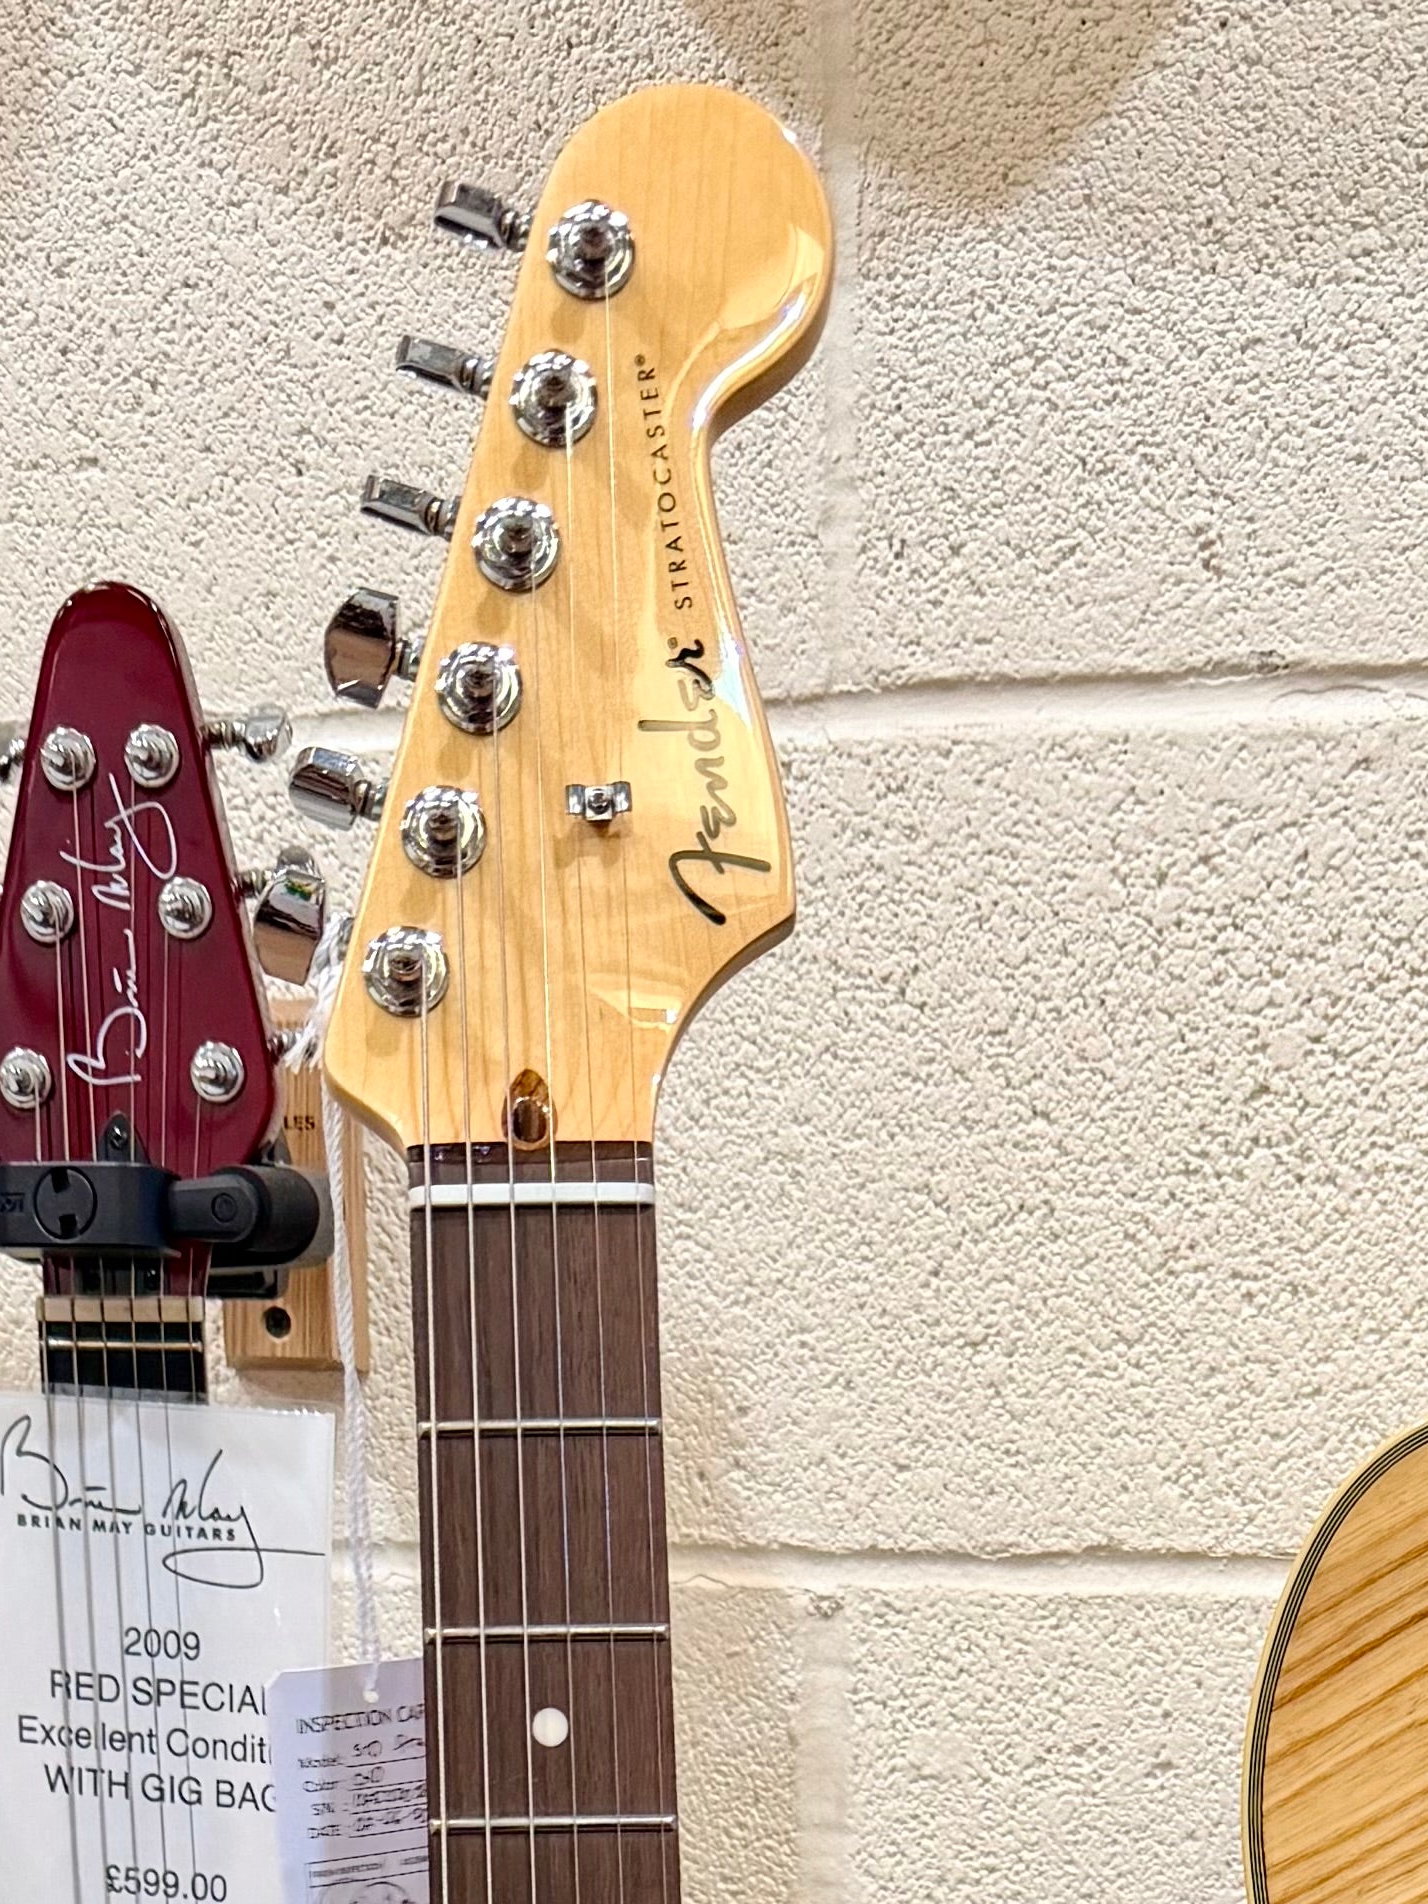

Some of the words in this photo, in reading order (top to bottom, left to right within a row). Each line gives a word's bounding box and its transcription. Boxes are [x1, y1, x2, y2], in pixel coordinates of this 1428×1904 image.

[17, 1514, 82, 1532] BRIAN
[93, 1520, 133, 1536] MAY
[145, 1522, 236, 1542] GUITARS
[124, 1627, 201, 1661] 2009
[50, 1669, 121, 1703] RED
[18, 1715, 156, 1756] Excellent
[166, 1727, 271, 1765] Condit
[43, 1764, 130, 1801] WITH
[140, 1773, 202, 1806] GIG
[105, 1866, 227, 1903] £599.00
